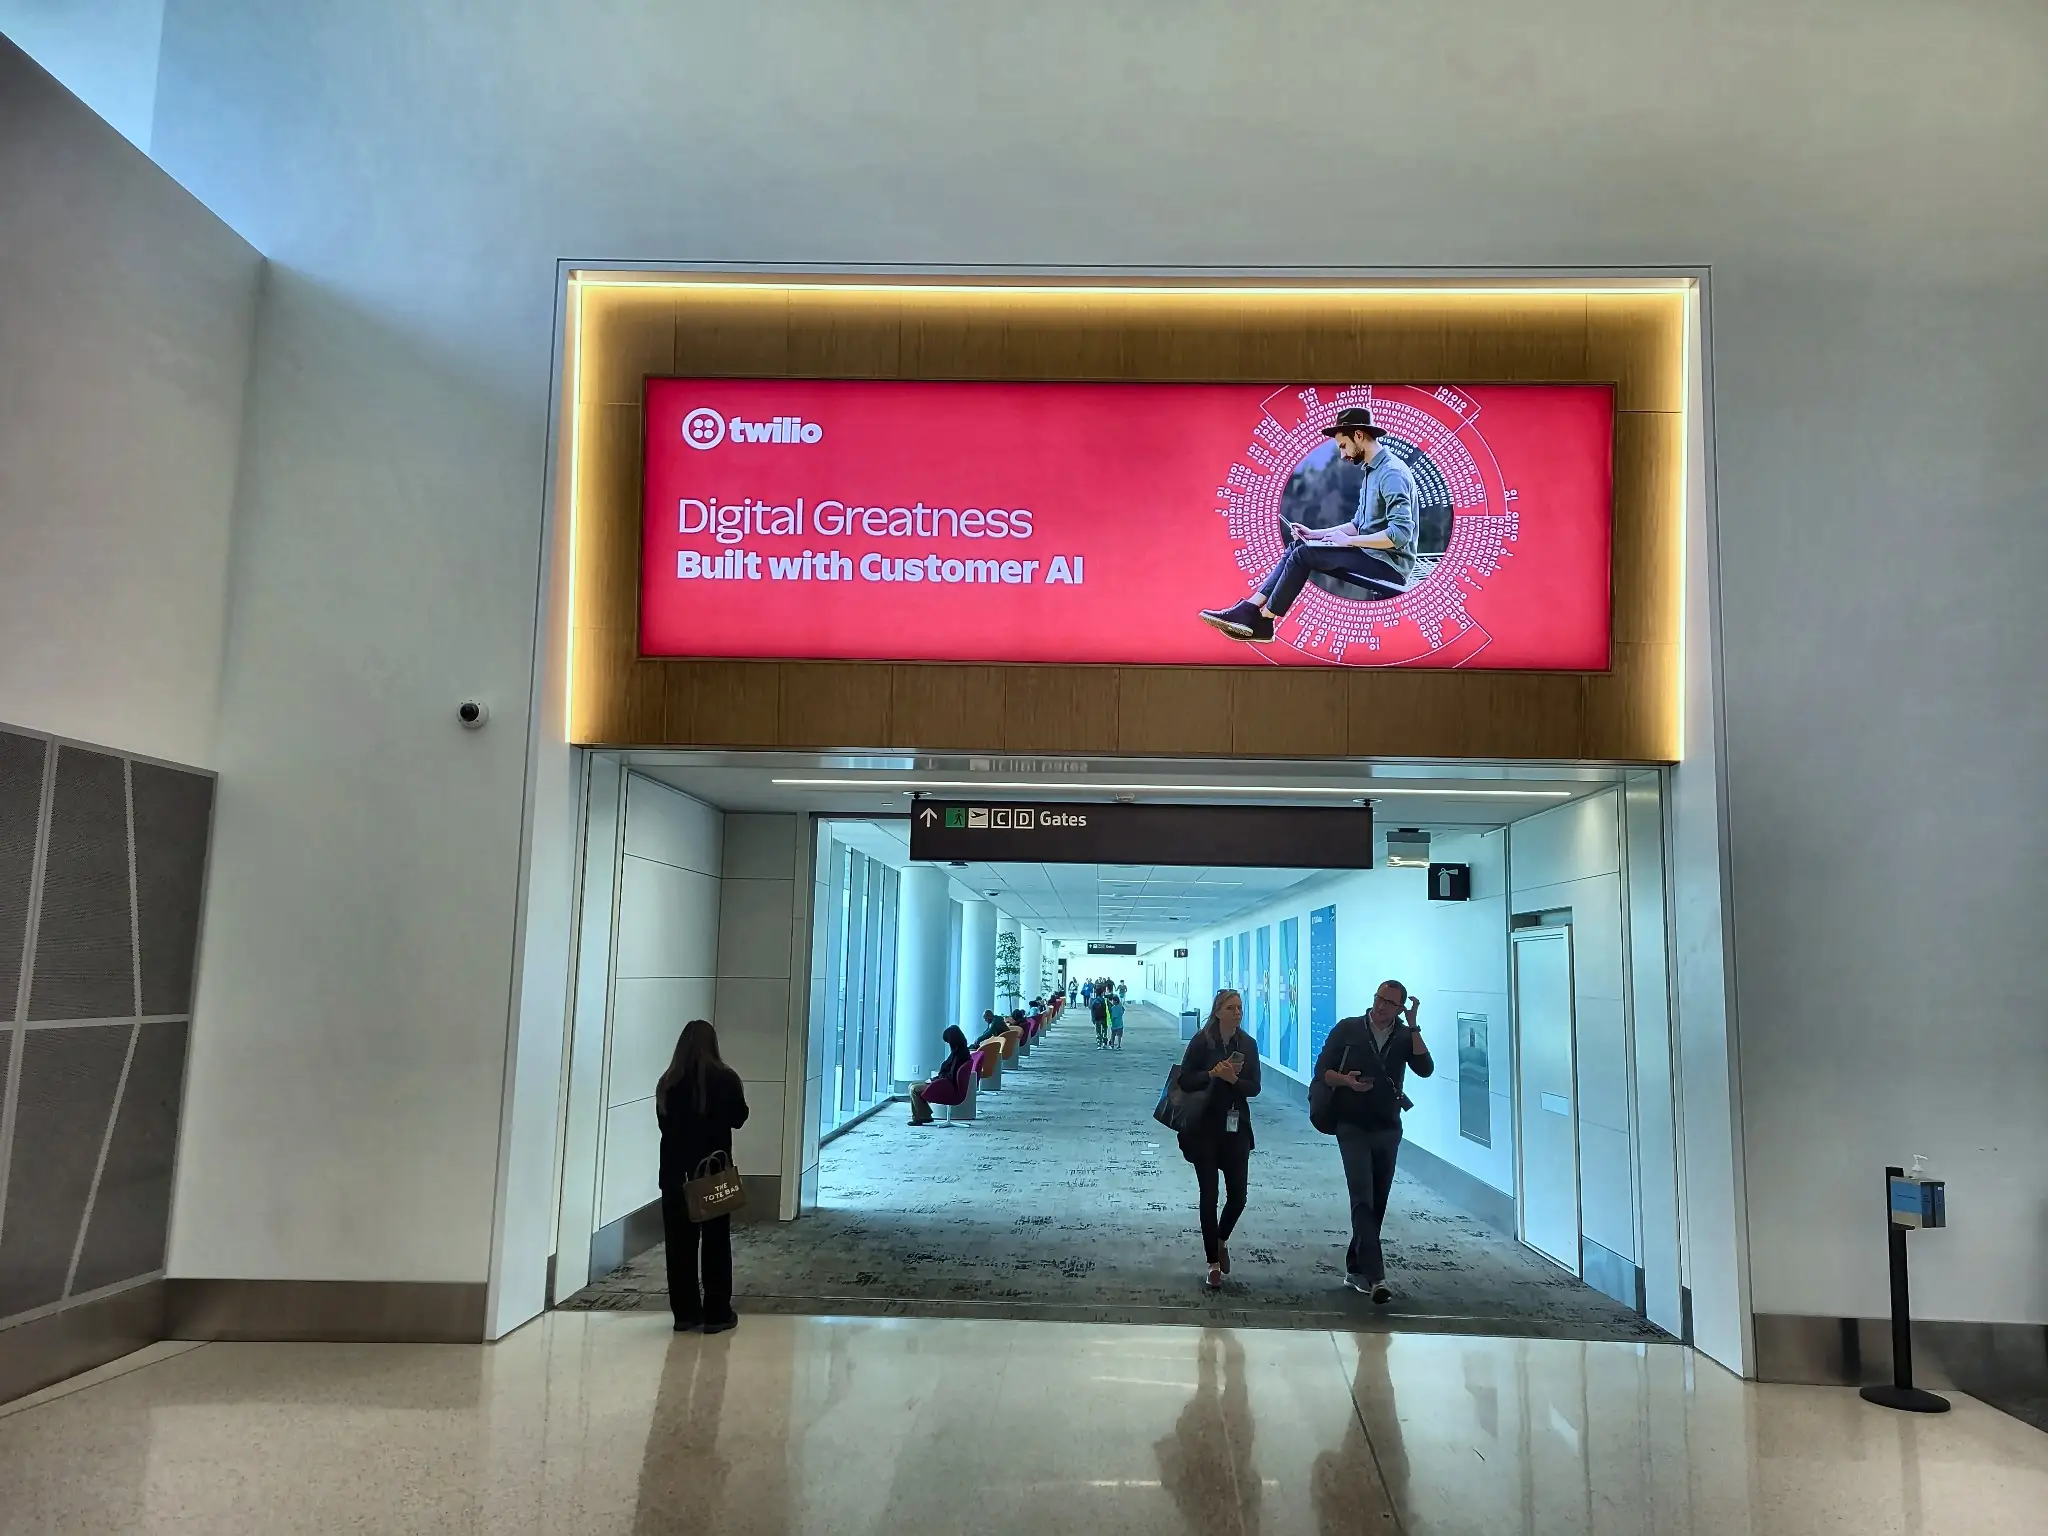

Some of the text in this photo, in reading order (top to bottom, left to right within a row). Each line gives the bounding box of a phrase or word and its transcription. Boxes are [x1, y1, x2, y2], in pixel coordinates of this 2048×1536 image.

[729, 416, 823, 444] twilio
[678, 497, 1034, 544] Digital Greatness
[677, 548, 1084, 584] Built with Customer AI
[996, 810, 1087, 827] C D Gates
[703, 1191, 724, 1201] TOTE
[714, 1182, 728, 1191] THE
